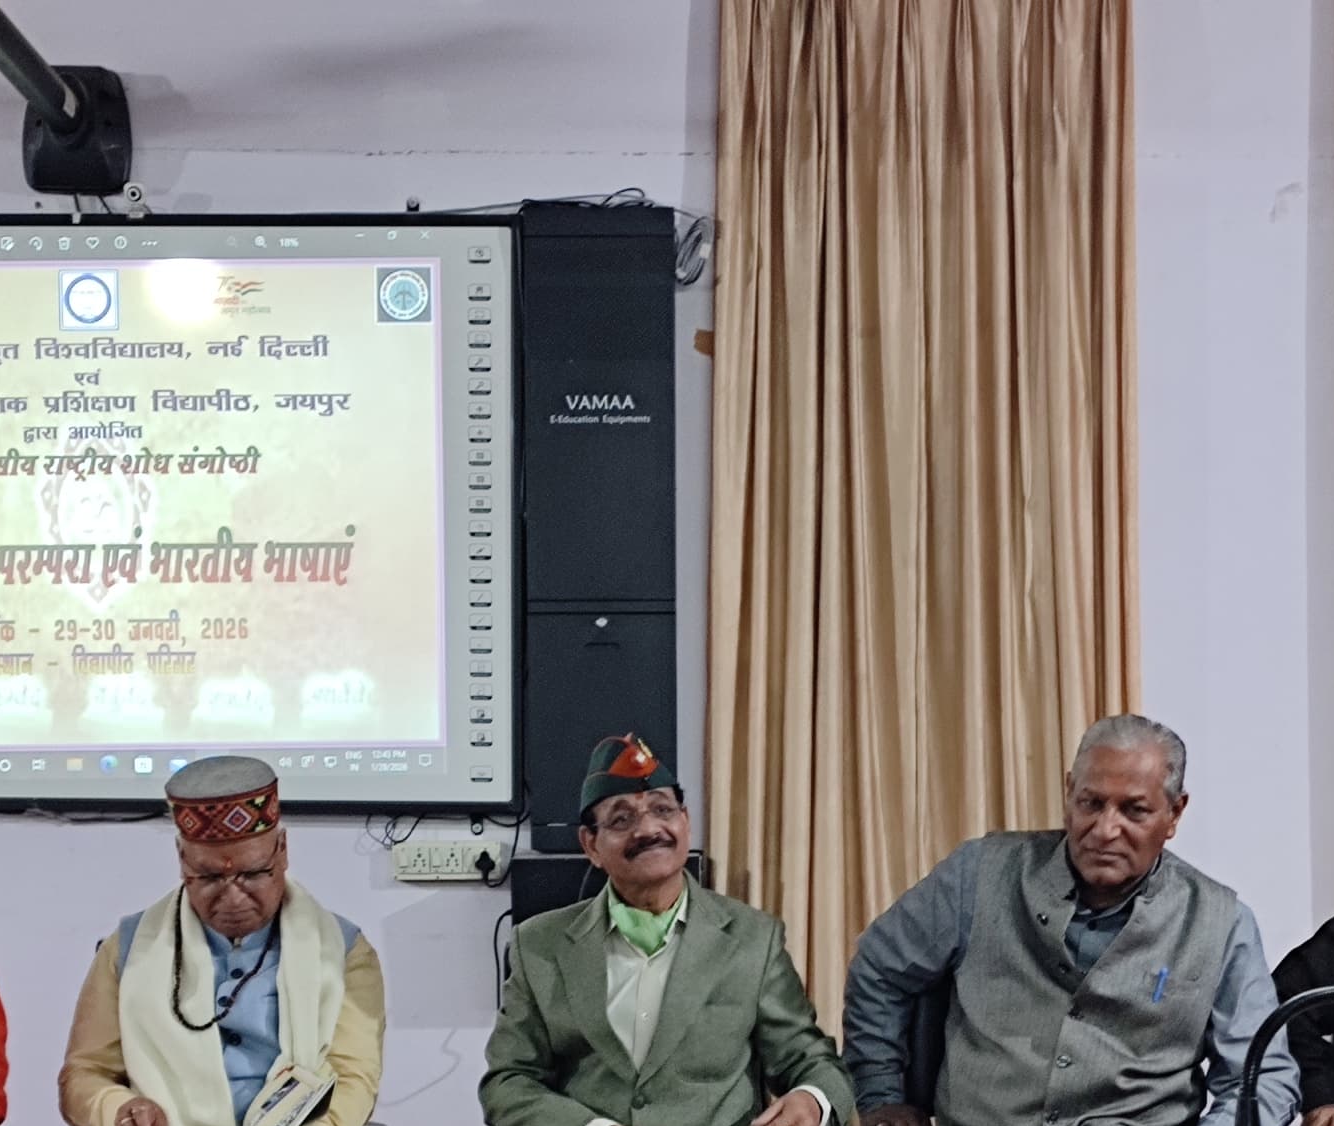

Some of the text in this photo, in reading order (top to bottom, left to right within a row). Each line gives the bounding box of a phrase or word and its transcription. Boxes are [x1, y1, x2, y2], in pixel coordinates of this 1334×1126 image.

[206, 335, 248, 358] नई
[258, 335, 329, 360] दिल्ली
[74, 368, 100, 386] एवं
[43, 391, 136, 413] प्रशिक्षण
[152, 389, 259, 413] विद्यापीठ,
[274, 393, 351, 416] जयपुर
[565, 394, 635, 411] VAMAA
[23, 421, 142, 443] द्वारा आयोजित
[602, 414, 651, 426] Equipments
[43, 447, 116, 481] राष्ट्रीय
[120, 447, 173, 475] शोध
[178, 445, 262, 475] संगोष्ठी
[0, 544, 96, 586] परम्परा
[102, 526, 142, 588] एवं
[149, 526, 259, 583] भारतीय
[264, 524, 356, 586] भाषाएं
[54, 618, 115, 641] 29-30
[200, 617, 249, 640] 2026
